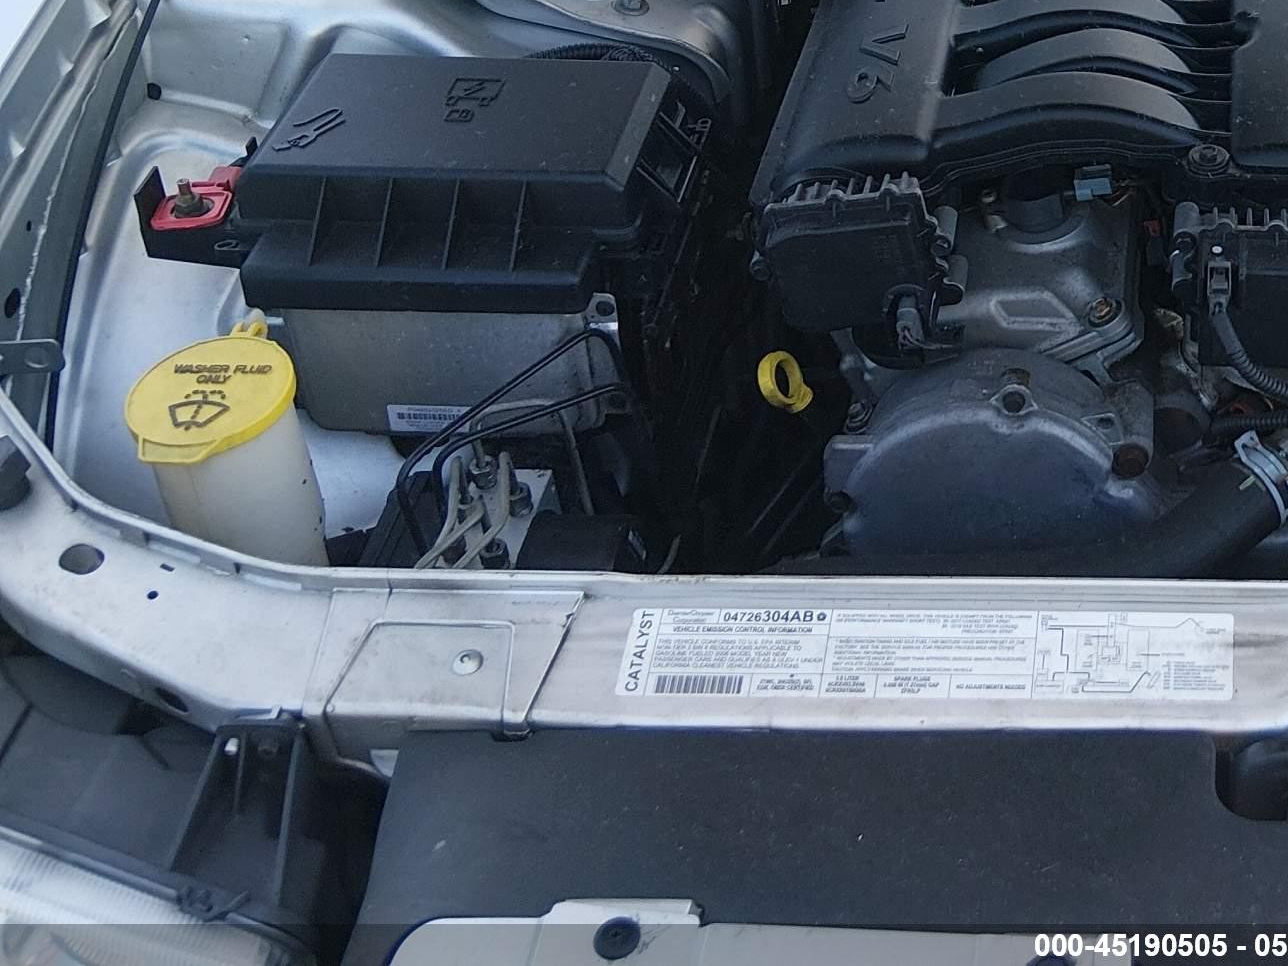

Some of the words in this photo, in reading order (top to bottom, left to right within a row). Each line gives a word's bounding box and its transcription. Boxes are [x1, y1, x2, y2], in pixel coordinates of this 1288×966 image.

[847, 22, 909, 104] V6
[173, 364, 231, 375] WASHER
[233, 364, 273, 375] FLUID
[196, 374, 233, 385] ONLY
[723, 610, 814, 623] 04726304AB
[625, 610, 655, 692] CATALYST
